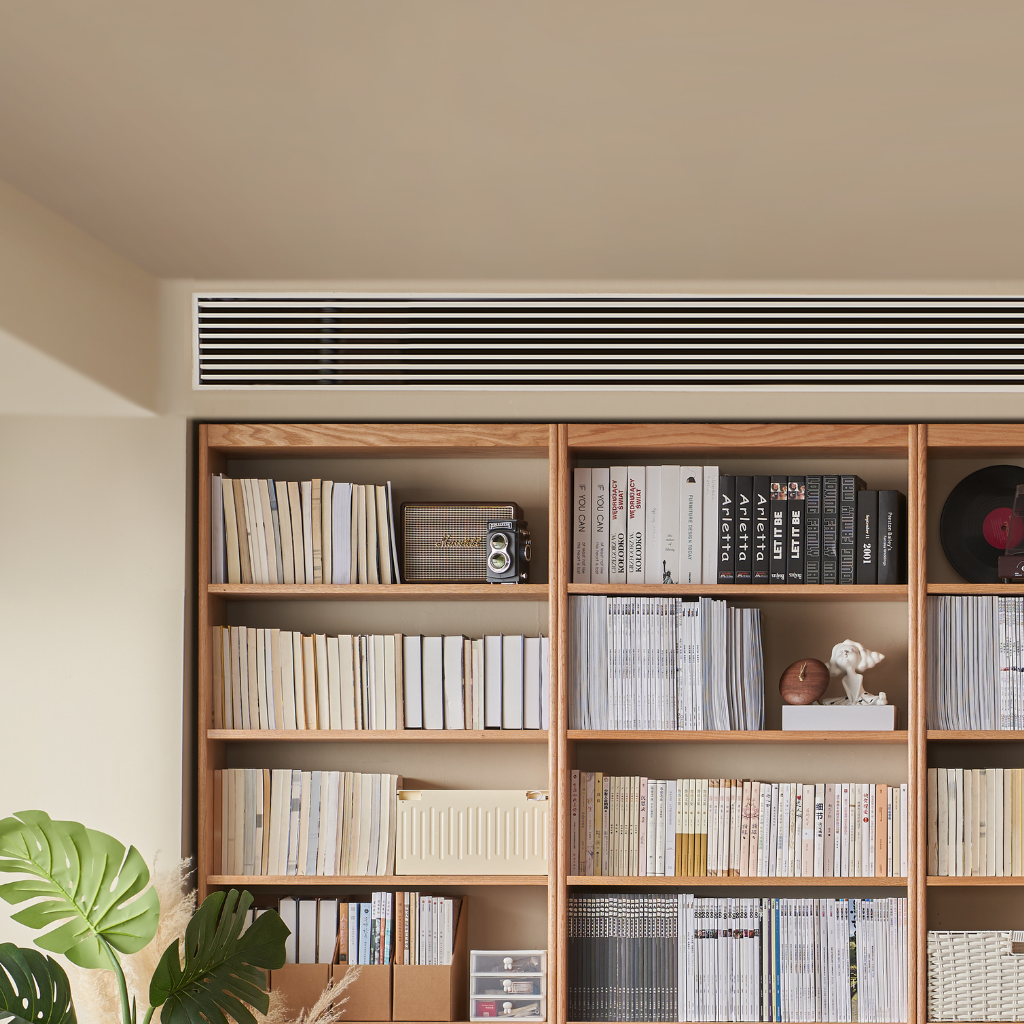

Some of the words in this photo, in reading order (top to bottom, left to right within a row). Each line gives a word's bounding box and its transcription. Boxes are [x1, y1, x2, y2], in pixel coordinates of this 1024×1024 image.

[807, 478, 820, 513] LOVING
[824, 478, 837, 513] LOVING
[841, 478, 854, 501] MAN
[721, 494, 732, 562] Arletta
[739, 494, 750, 561] Arletta
[757, 494, 767, 561] Arletta
[774, 512, 783, 525] BE
[791, 511, 800, 524] BE
[841, 506, 854, 544] FAMILY
[774, 528, 783, 537] IT
[791, 527, 800, 537] IT
[807, 518, 820, 556] FAMILY
[824, 518, 837, 556] FAMILY
[774, 540, 783, 559] LET
[791, 539, 800, 558] LET
[863, 543, 871, 564] 2001
[807, 561, 820, 584] MAN
[824, 561, 837, 584] MAN
[841, 549, 854, 584] LOVING
[816, 803, 823, 820] 细节
